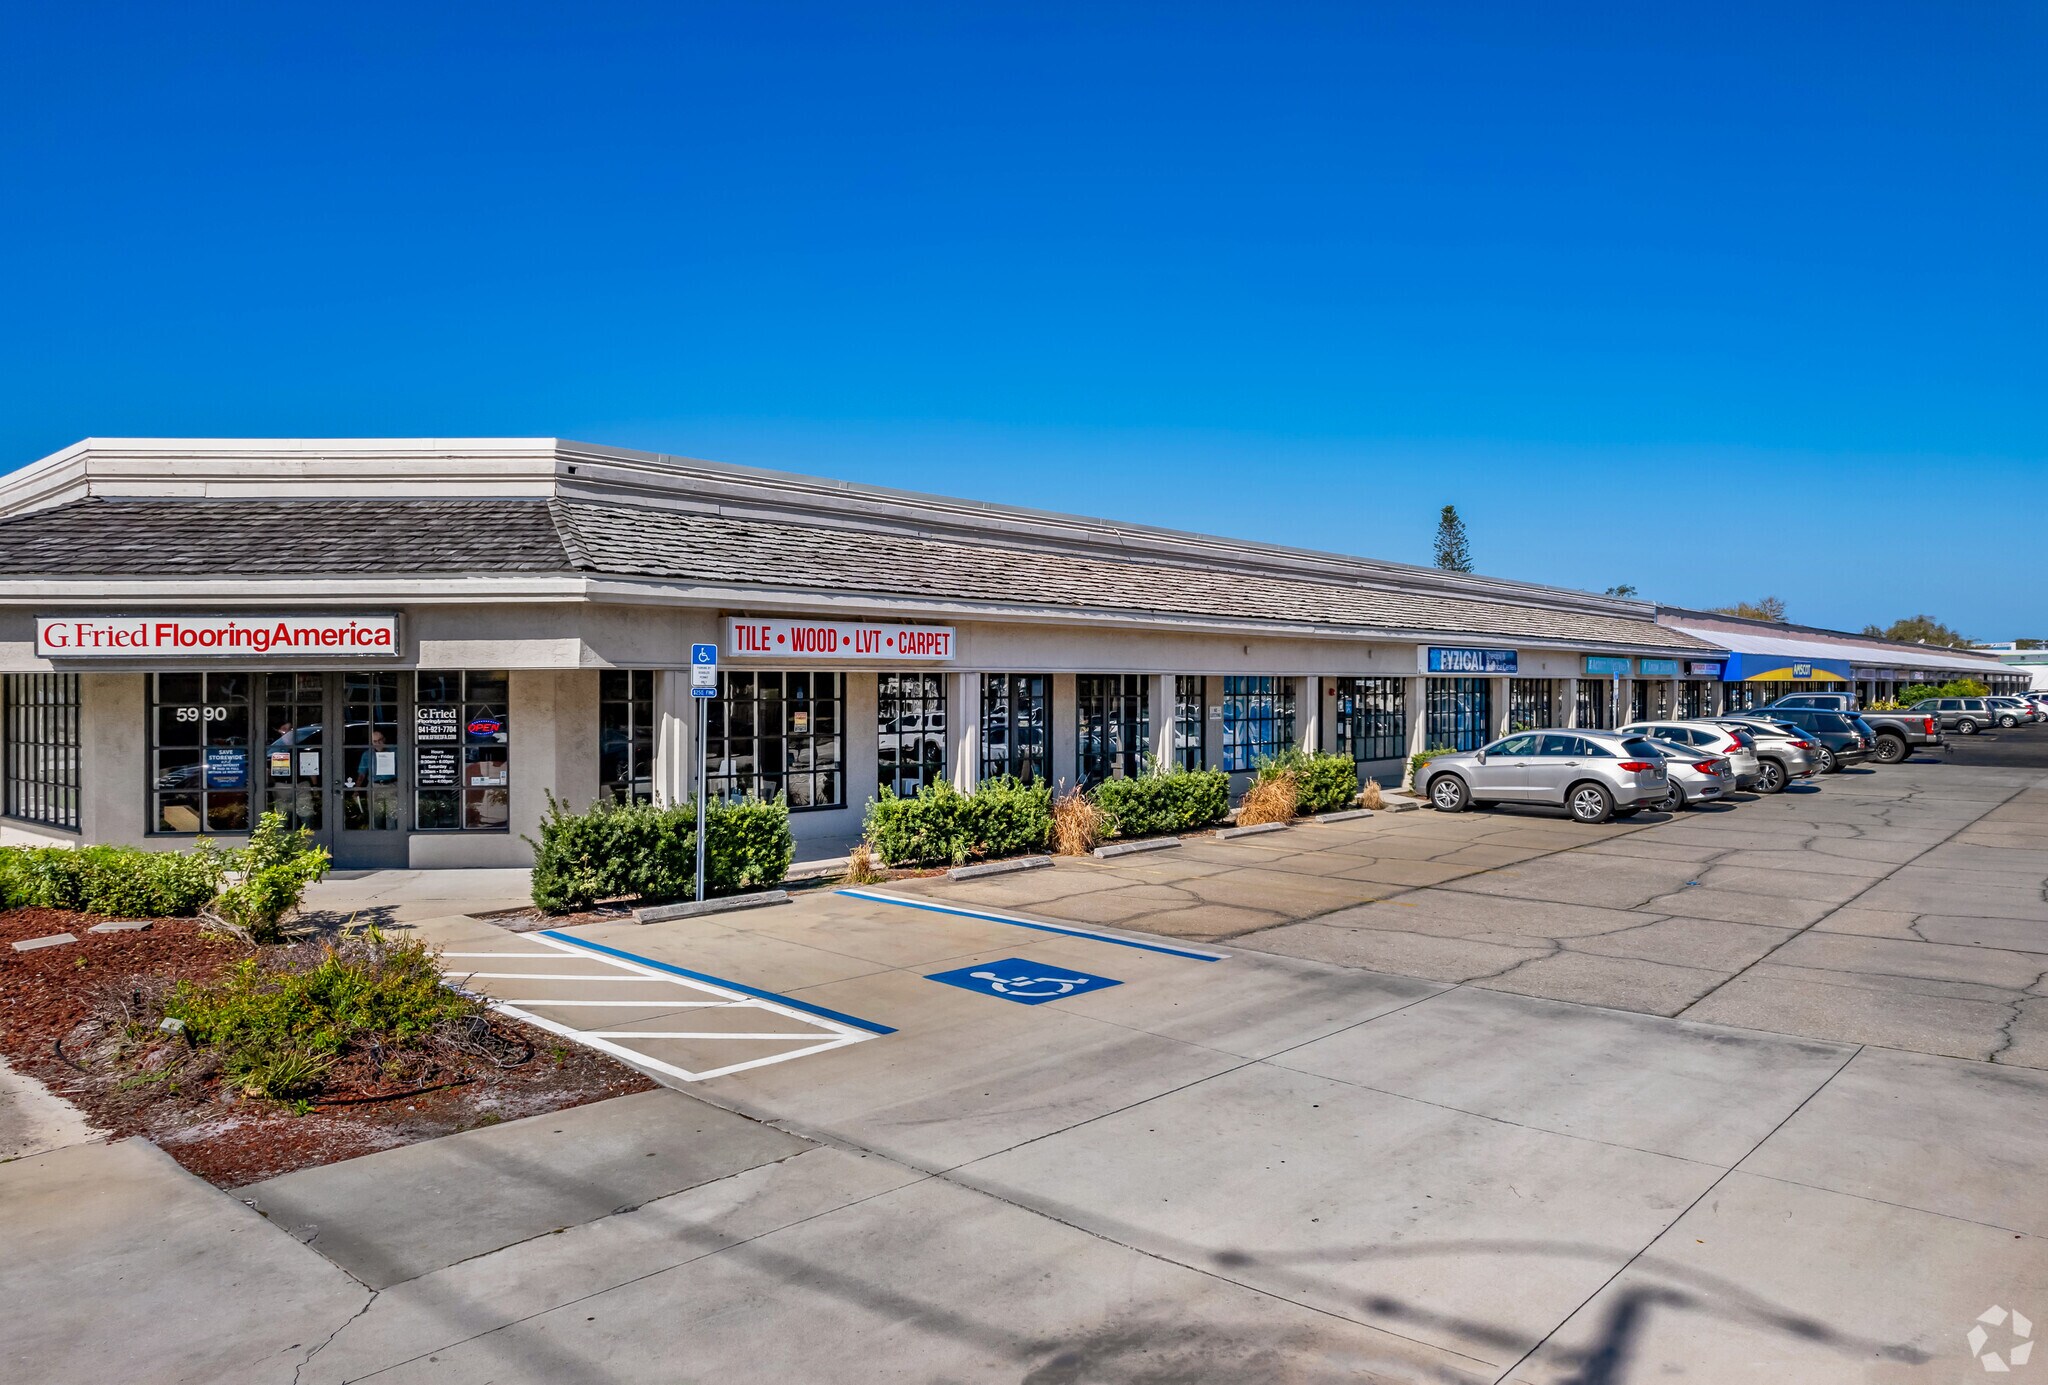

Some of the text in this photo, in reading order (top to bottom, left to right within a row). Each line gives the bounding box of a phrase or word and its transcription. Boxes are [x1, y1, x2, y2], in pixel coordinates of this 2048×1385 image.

[735, 625, 951, 656] TILE WOOD LVT CARPET
[1440, 650, 1484, 671] FYZICAL
[1793, 663, 1812, 676] AMSCOT
[467, 723, 500, 732] OPEN
